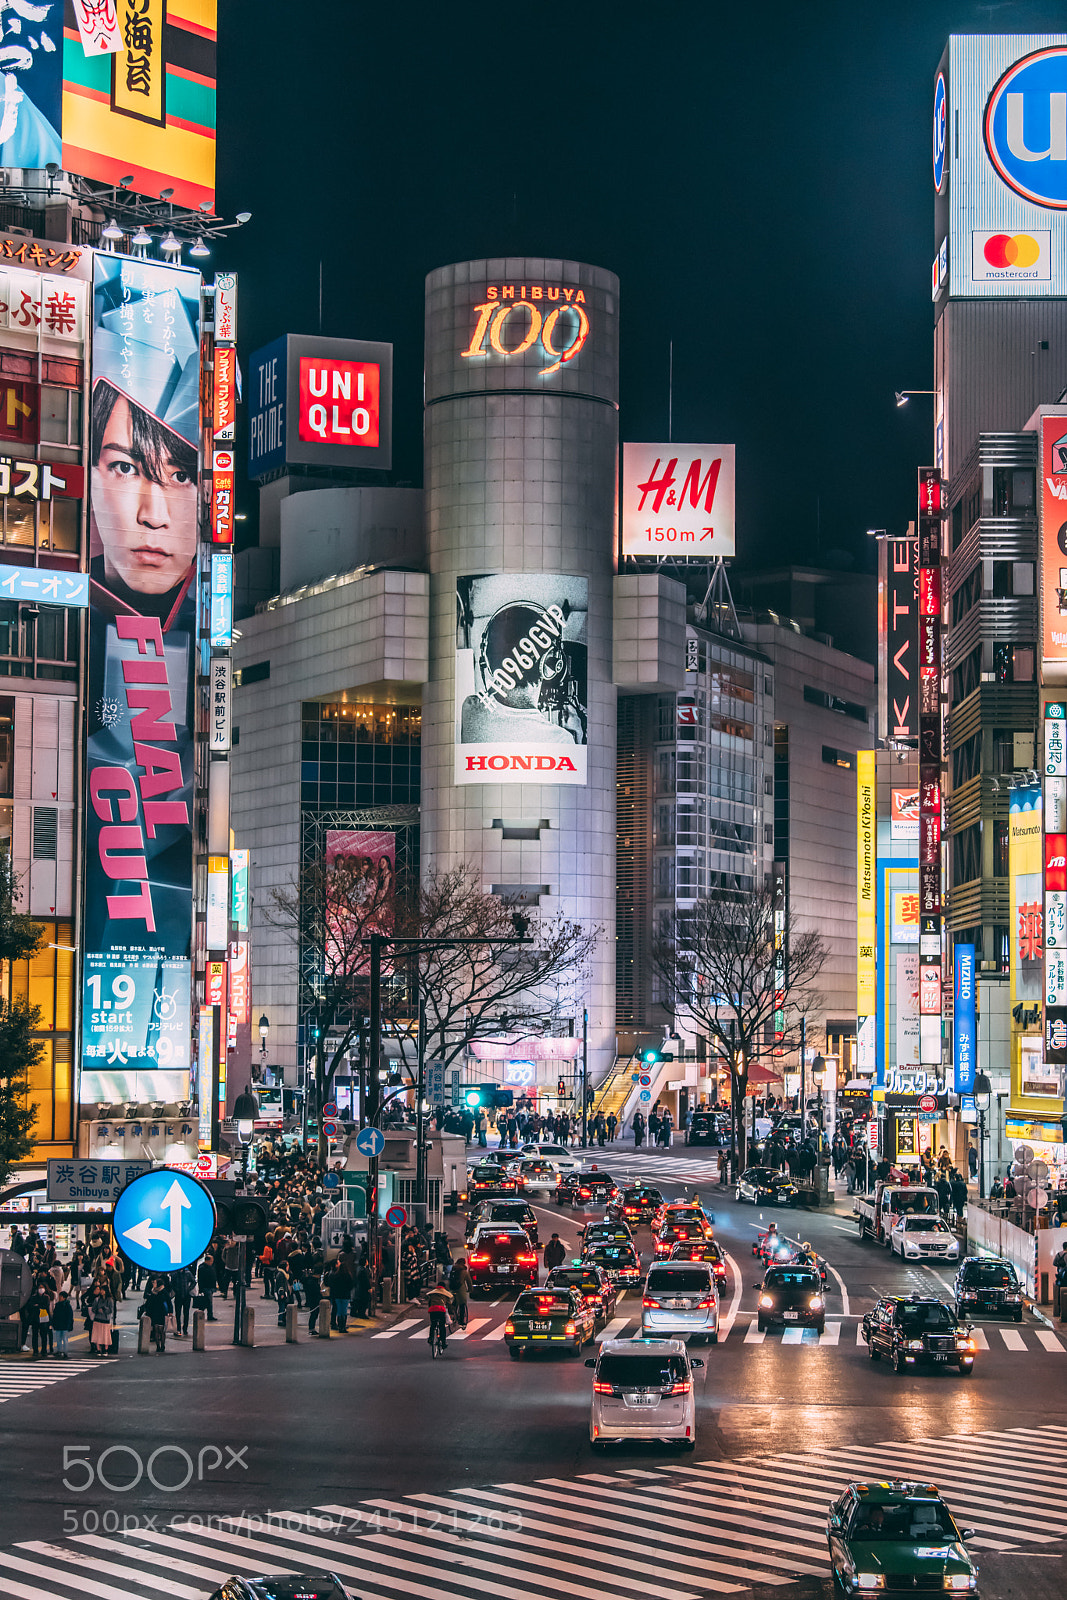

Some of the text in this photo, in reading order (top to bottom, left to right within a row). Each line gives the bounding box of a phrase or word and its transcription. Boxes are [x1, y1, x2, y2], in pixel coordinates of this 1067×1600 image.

[0, 239, 82, 272] バイキング
[985, 270, 1039, 278] mastercard
[486, 285, 586, 303] SHIBUYA
[120, 269, 134, 386] 切り撮ってやる。
[163, 279, 176, 364] 前らから、
[219, 291, 231, 337] しゃぶ葉
[460, 300, 590, 375] 109
[258, 357, 278, 408] THE
[308, 368, 365, 401] UNI
[221, 431, 233, 439] 8F
[250, 402, 284, 460] PRIME
[308, 403, 370, 438] QLO
[636, 457, 722, 515] H&M
[216, 490, 231, 534] ガスト
[2, 571, 84, 599] イーオン
[216, 594, 227, 638] イーオン
[101, 713, 118, 722] ドラマ
[214, 665, 227, 743] 渋谷駅前ビル
[115, 614, 190, 839] FINAL
[465, 755, 578, 771] HONDA
[862, 785, 872, 900] Matsumoto KiYoshi
[1011, 824, 1041, 837] Matsumoto
[89, 765, 157, 933] CUT
[1047, 856, 1066, 868] JTB
[235, 881, 245, 911] レイク
[923, 874, 935, 910] 餃子屋台
[1018, 901, 1042, 961] 薬
[1056, 902, 1065, 932] フルーツ
[86, 974, 136, 1010] 1.9
[233, 975, 245, 1006] アコム
[961, 954, 972, 1000] MIZUHO
[1048, 964, 1056, 993] フルーツ
[91, 1010, 133, 1024] start
[148, 1022, 184, 1031] フジテレビ
[86, 1036, 185, 1065] 毎週火曜よる9時
[959, 1033, 970, 1082] みずほ銀行
[506, 1070, 533, 1086] 109
[98, 1125, 192, 1137] 渋谷駅前ビル
[870, 1124, 878, 1150] KIRIN
[56, 1165, 145, 1184] 渋谷駅前
[69, 1187, 110, 1199] Shibuya
